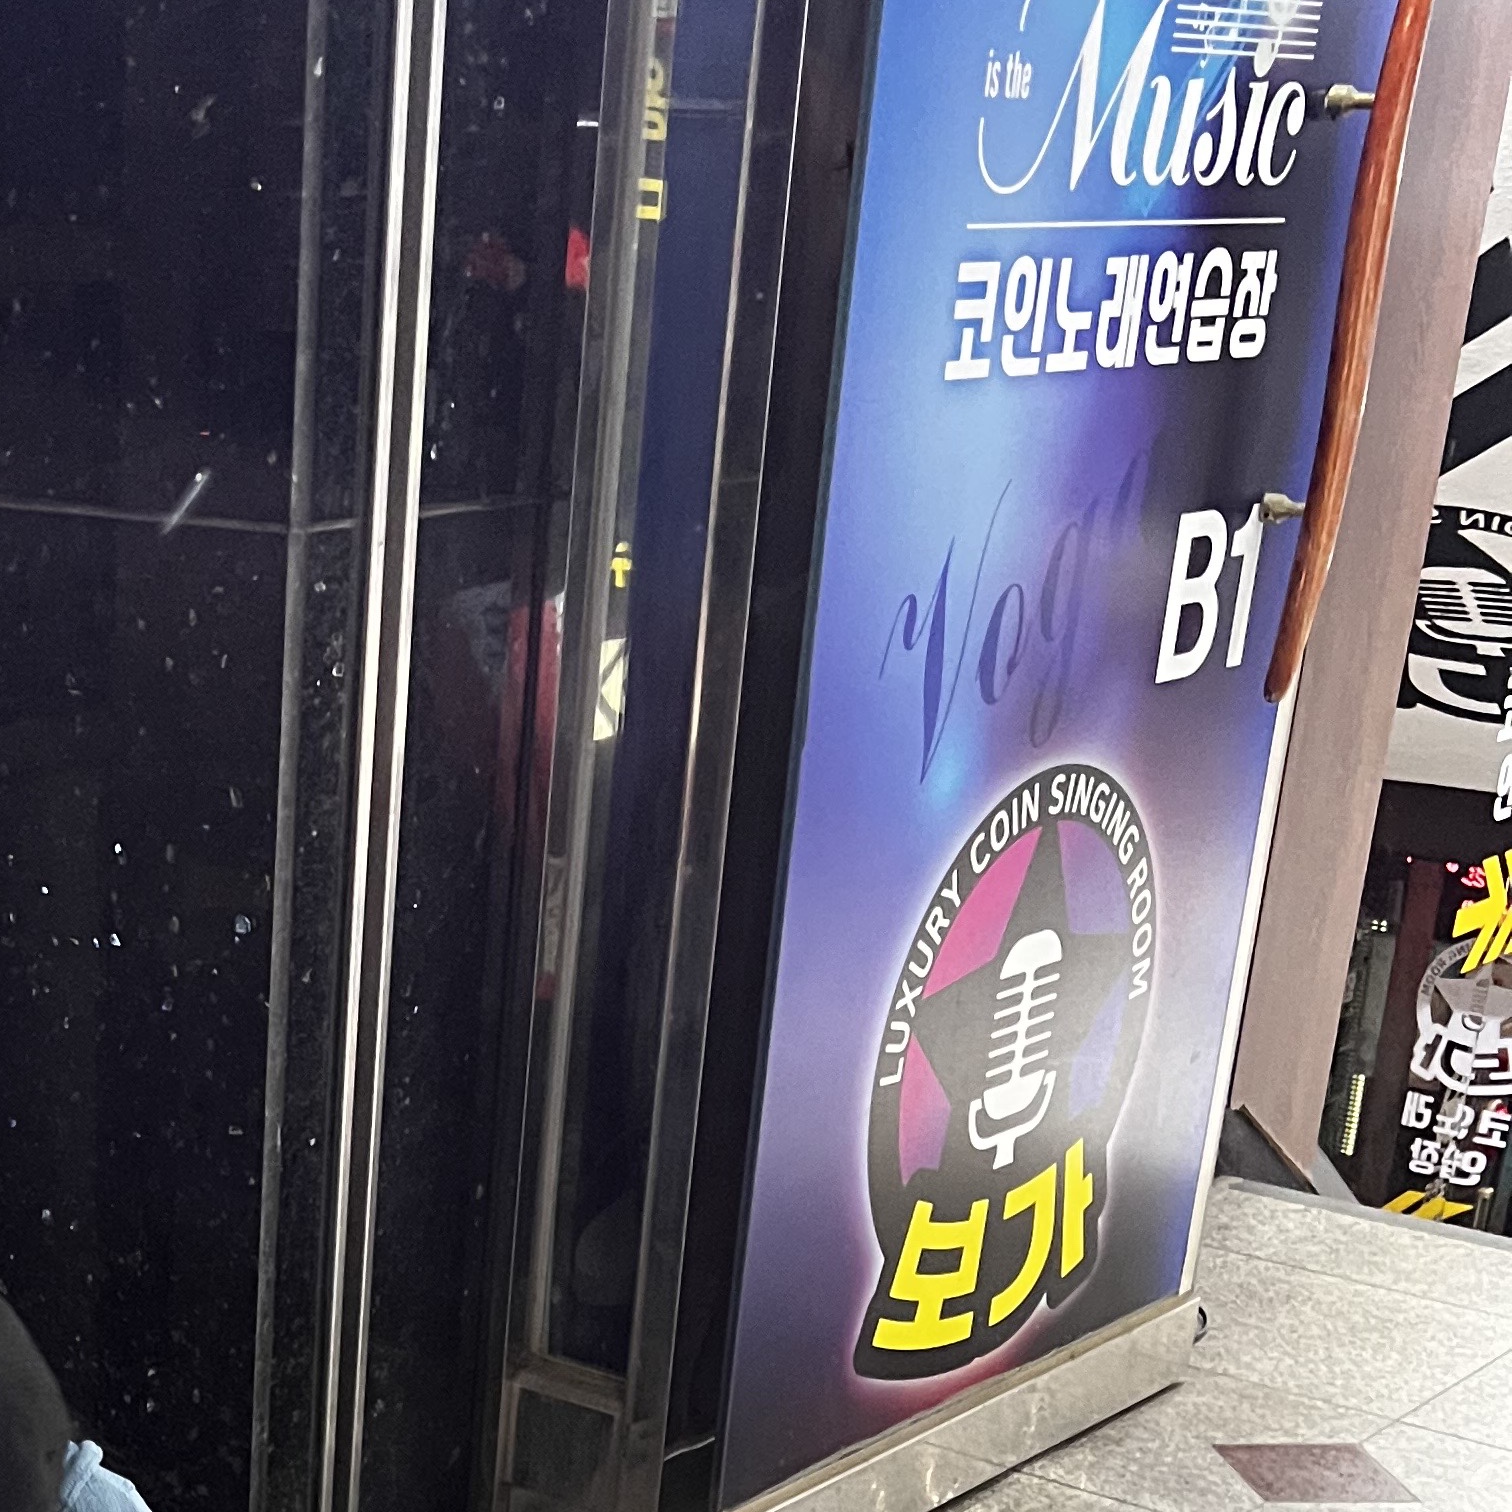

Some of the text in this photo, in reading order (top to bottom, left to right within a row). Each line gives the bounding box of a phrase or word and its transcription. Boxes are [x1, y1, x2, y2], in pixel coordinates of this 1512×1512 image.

[978, 0, 1306, 194] Music
[984, 48, 1032, 99] is the
[944, 246, 1278, 381] 코인노래연습장
[1154, 502, 1264, 684] B1
[879, 773, 1152, 1087] LUXURY COIN SINGING ROOM
[872, 1137, 1093, 1352] 보가
